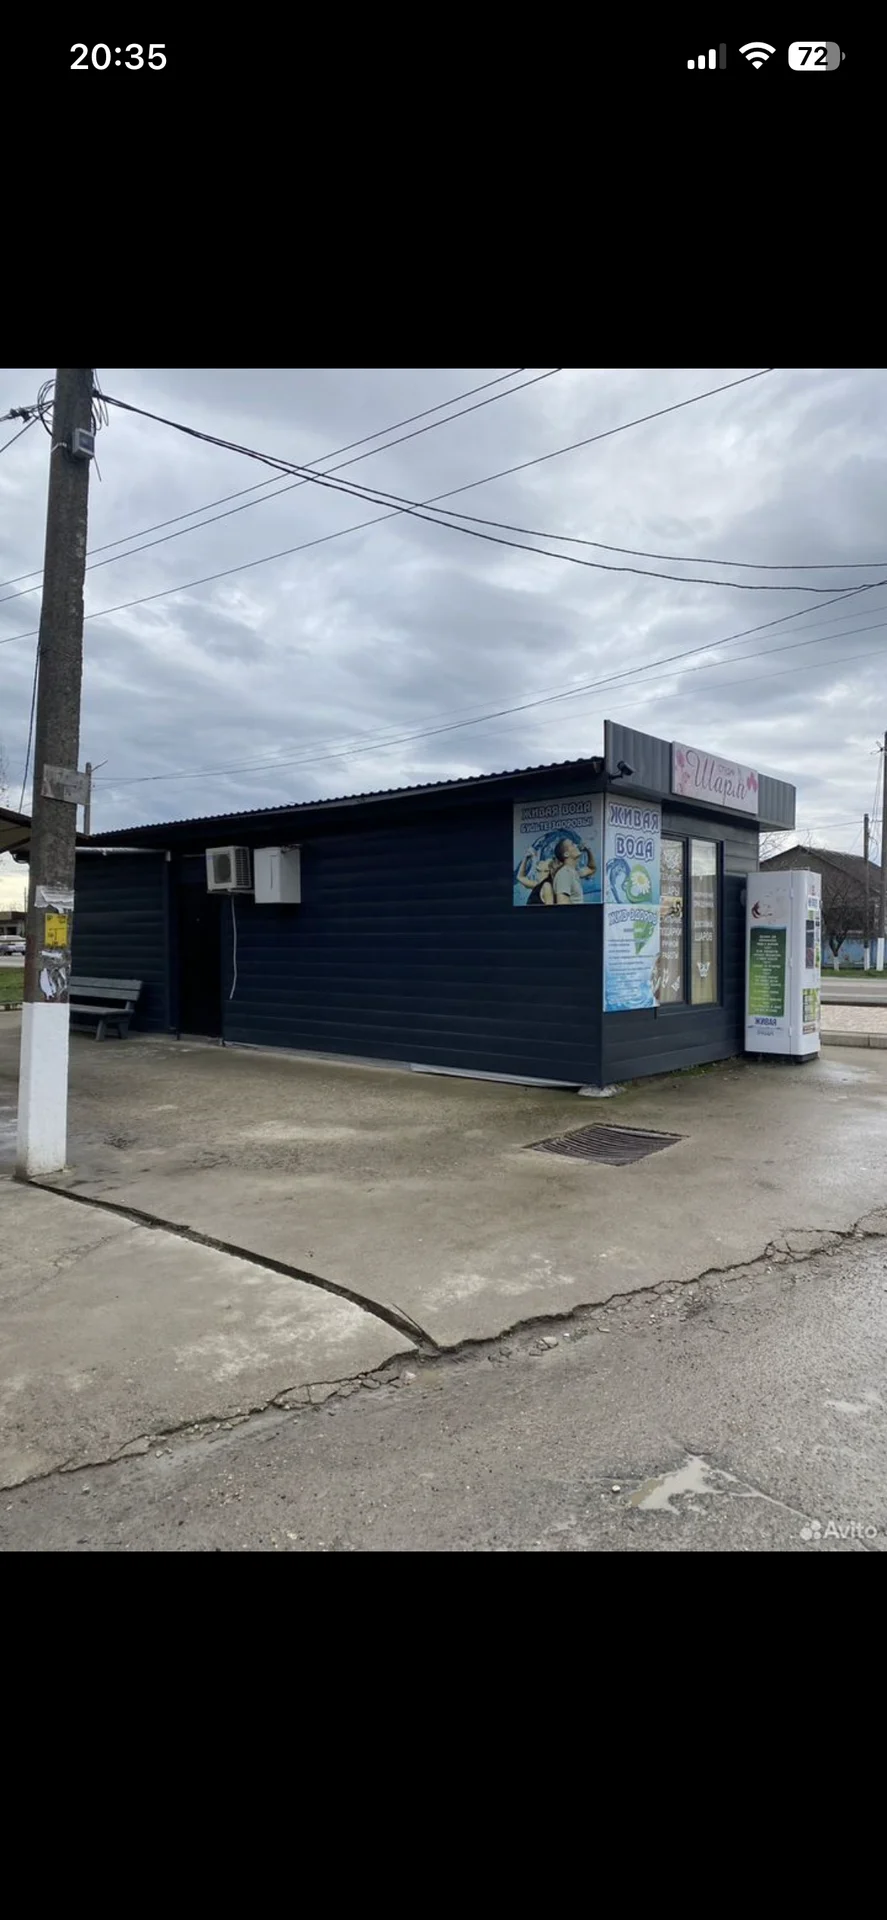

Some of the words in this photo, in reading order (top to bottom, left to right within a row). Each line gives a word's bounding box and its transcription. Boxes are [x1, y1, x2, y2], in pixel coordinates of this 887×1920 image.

[685, 749, 748, 806] Шарм
[521, 804, 559, 820] ЖИВАЯ
[561, 800, 592, 815] ВОДА
[609, 802, 660, 833] ЖИВАЯ
[615, 833, 655, 861] ВОДА
